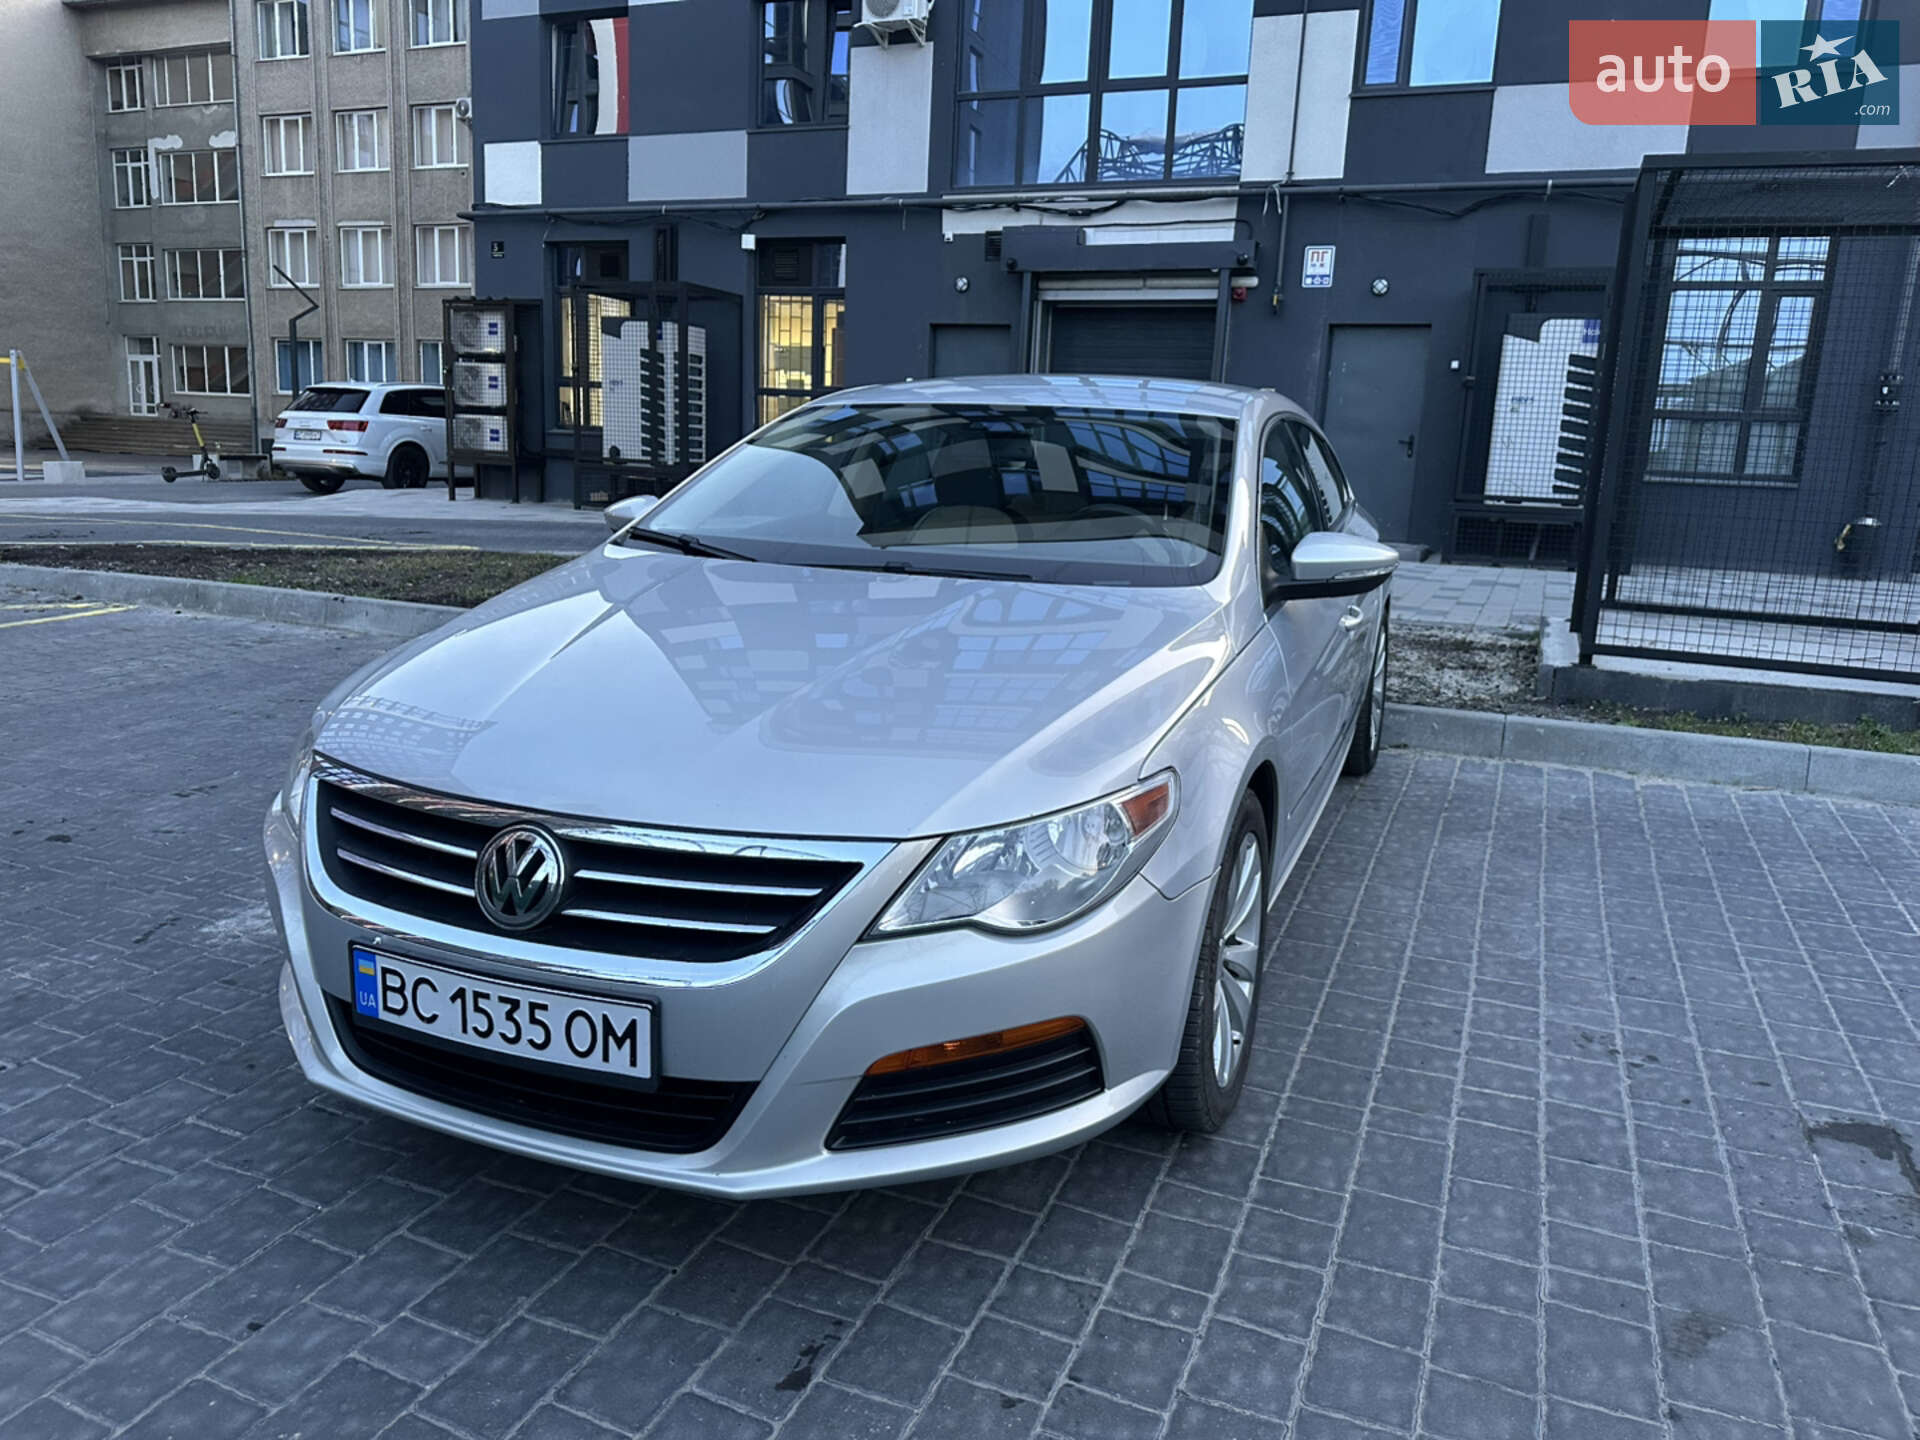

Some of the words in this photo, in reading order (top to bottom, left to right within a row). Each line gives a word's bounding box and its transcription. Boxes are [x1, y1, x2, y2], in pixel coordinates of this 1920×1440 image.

[359, 990, 377, 1009] UA
[379, 965, 440, 1025] BC
[449, 986, 552, 1051] 1535
[564, 1008, 638, 1069] OM
